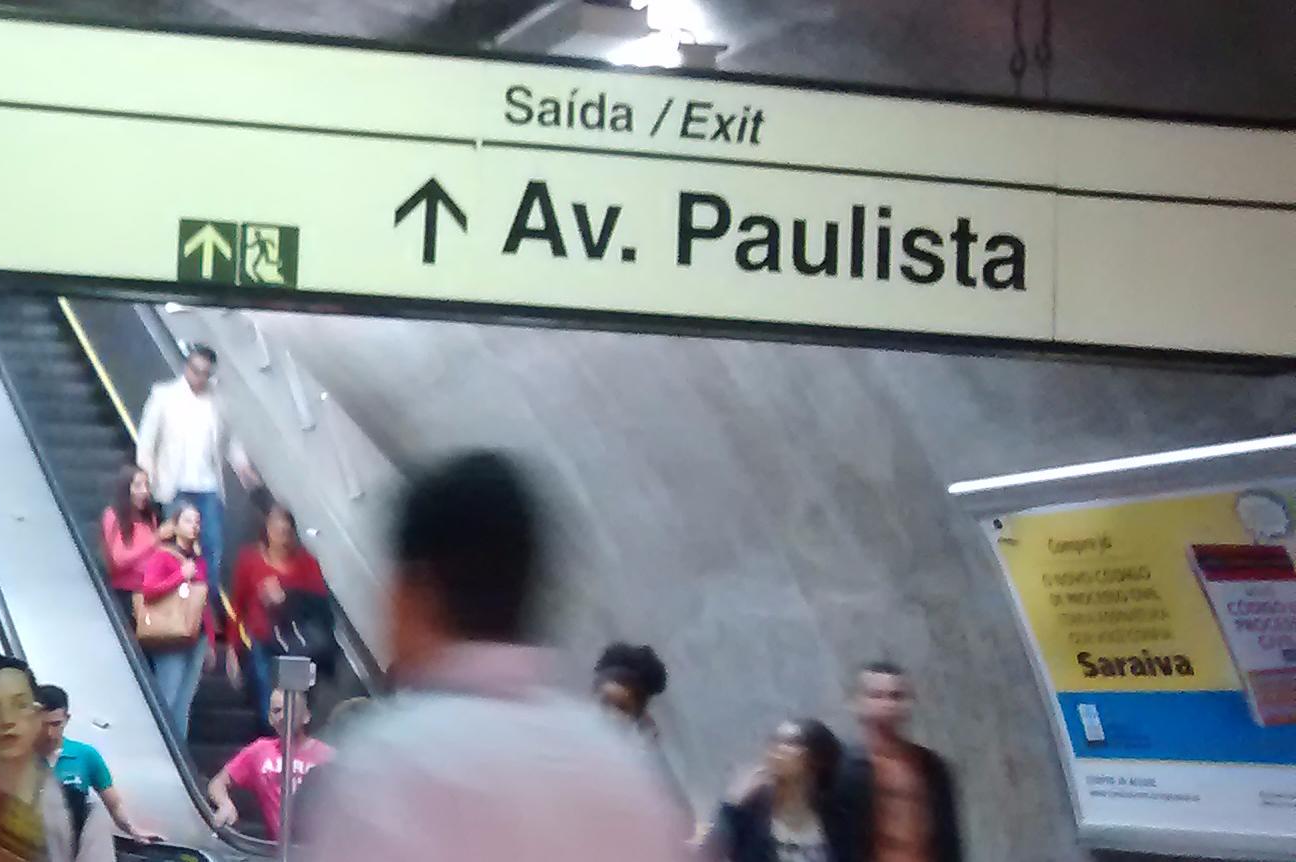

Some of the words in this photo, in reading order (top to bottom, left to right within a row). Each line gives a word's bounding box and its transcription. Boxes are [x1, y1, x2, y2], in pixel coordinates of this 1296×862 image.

[505, 84, 633, 132] Saída
[680, 101, 766, 145] Exit
[502, 180, 636, 262] Av.
[677, 191, 1028, 292] Paulista
[1076, 648, 1195, 679] Saraiva
